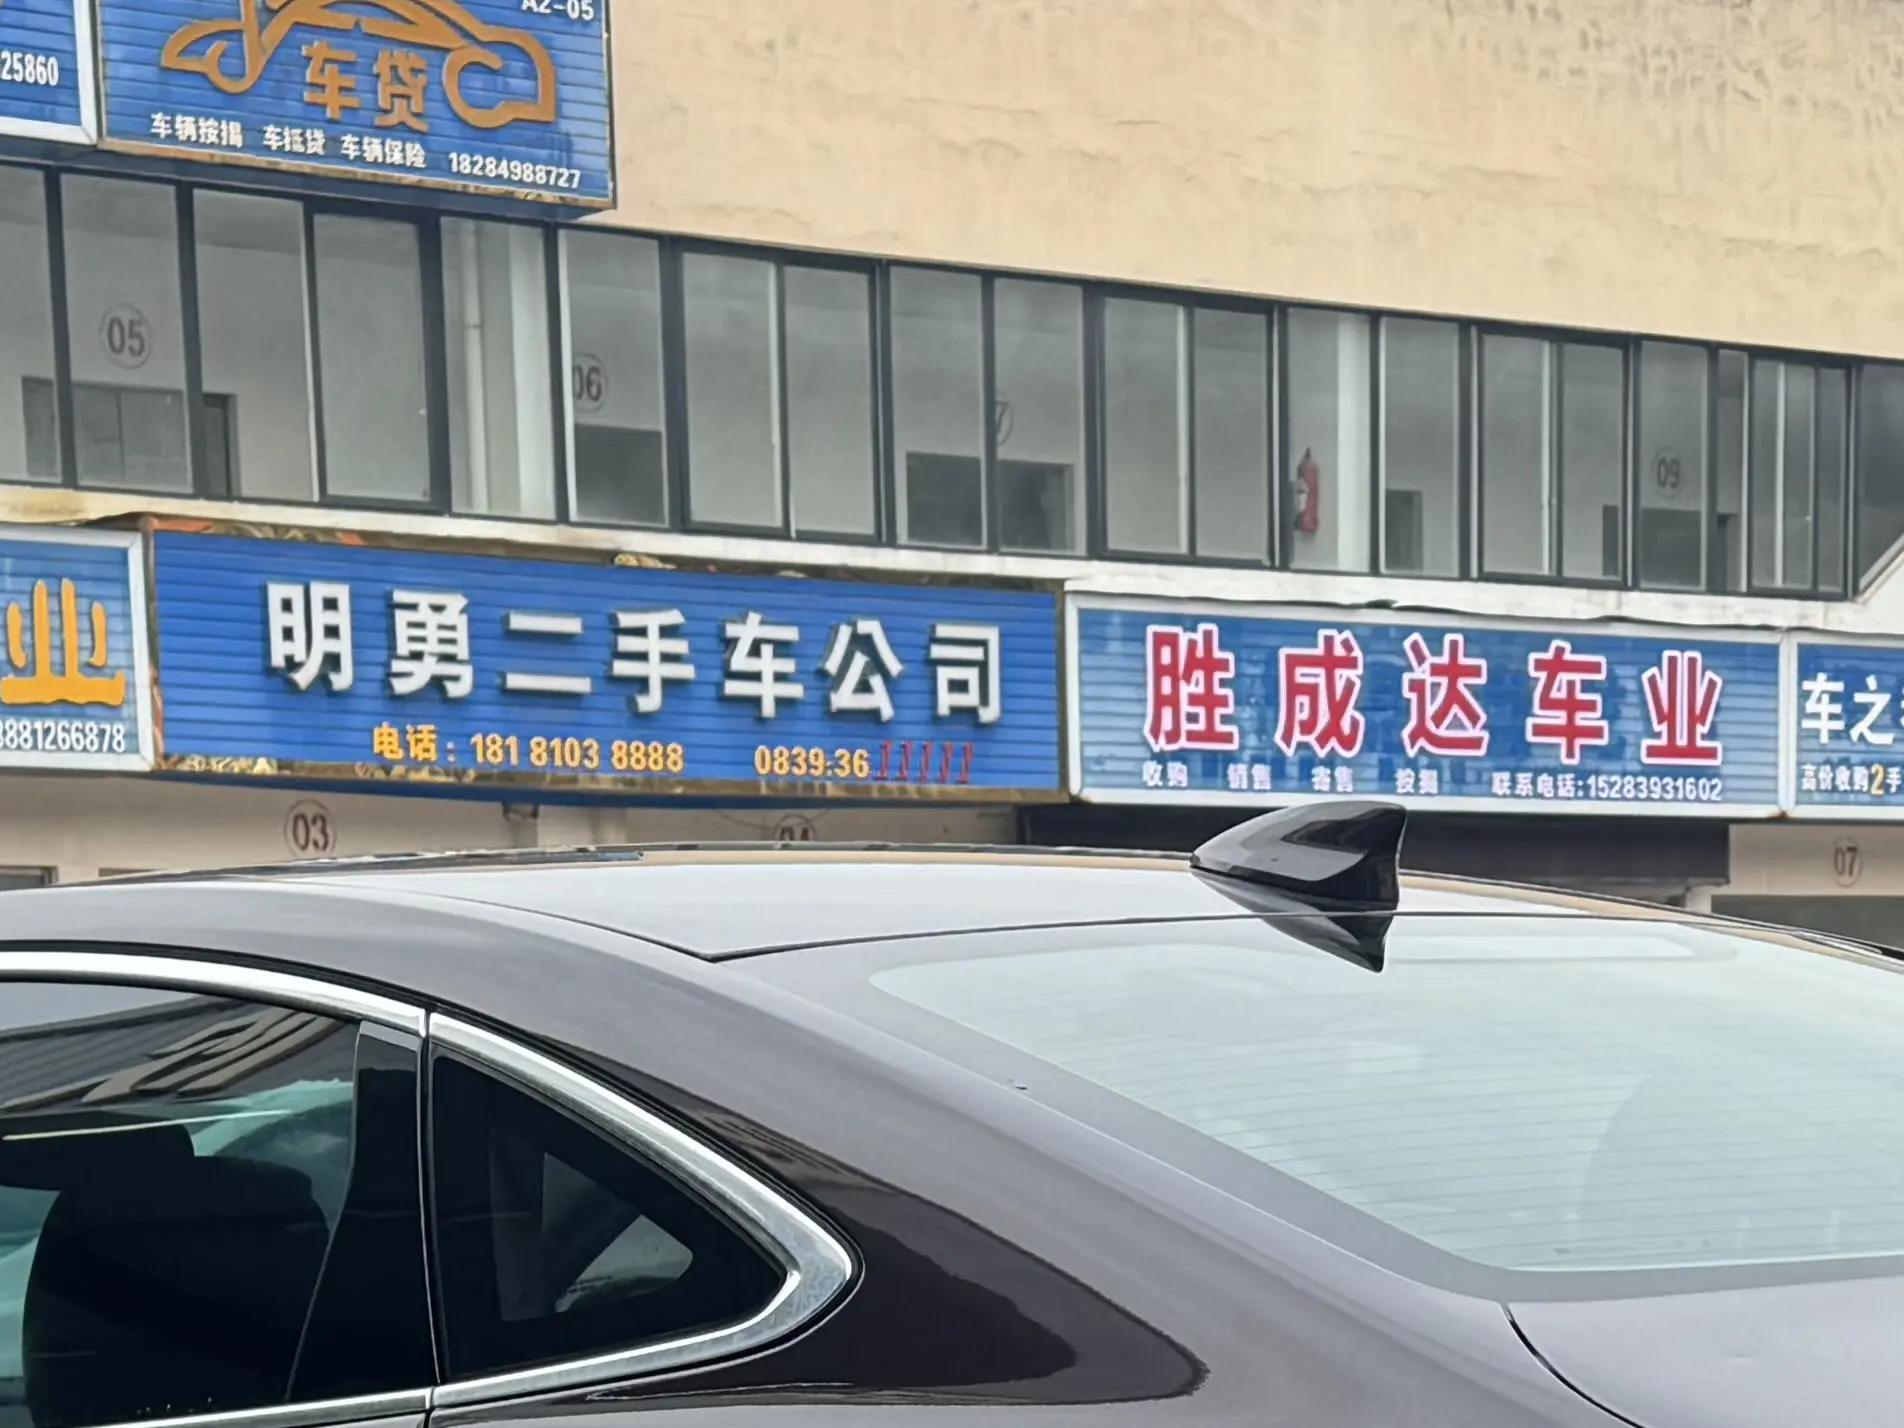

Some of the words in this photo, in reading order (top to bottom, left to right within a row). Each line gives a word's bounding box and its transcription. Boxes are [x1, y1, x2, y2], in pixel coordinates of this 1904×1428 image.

[301, 41, 429, 132] 车贷
[150, 111, 243, 149] 车辆按揭
[340, 133, 427, 168] 车辆保险
[448, 152, 581, 189] 18284988727
[106, 318, 146, 357] 05
[266, 581, 1006, 726] 明勇二手车公司
[1143, 623, 1724, 766] 胜成达车业
[469, 732, 519, 768] 181
[529, 735, 600, 770] 8103
[610, 738, 685, 774] 8888
[291, 814, 330, 851] 03
[1833, 846, 1859, 875] 07
